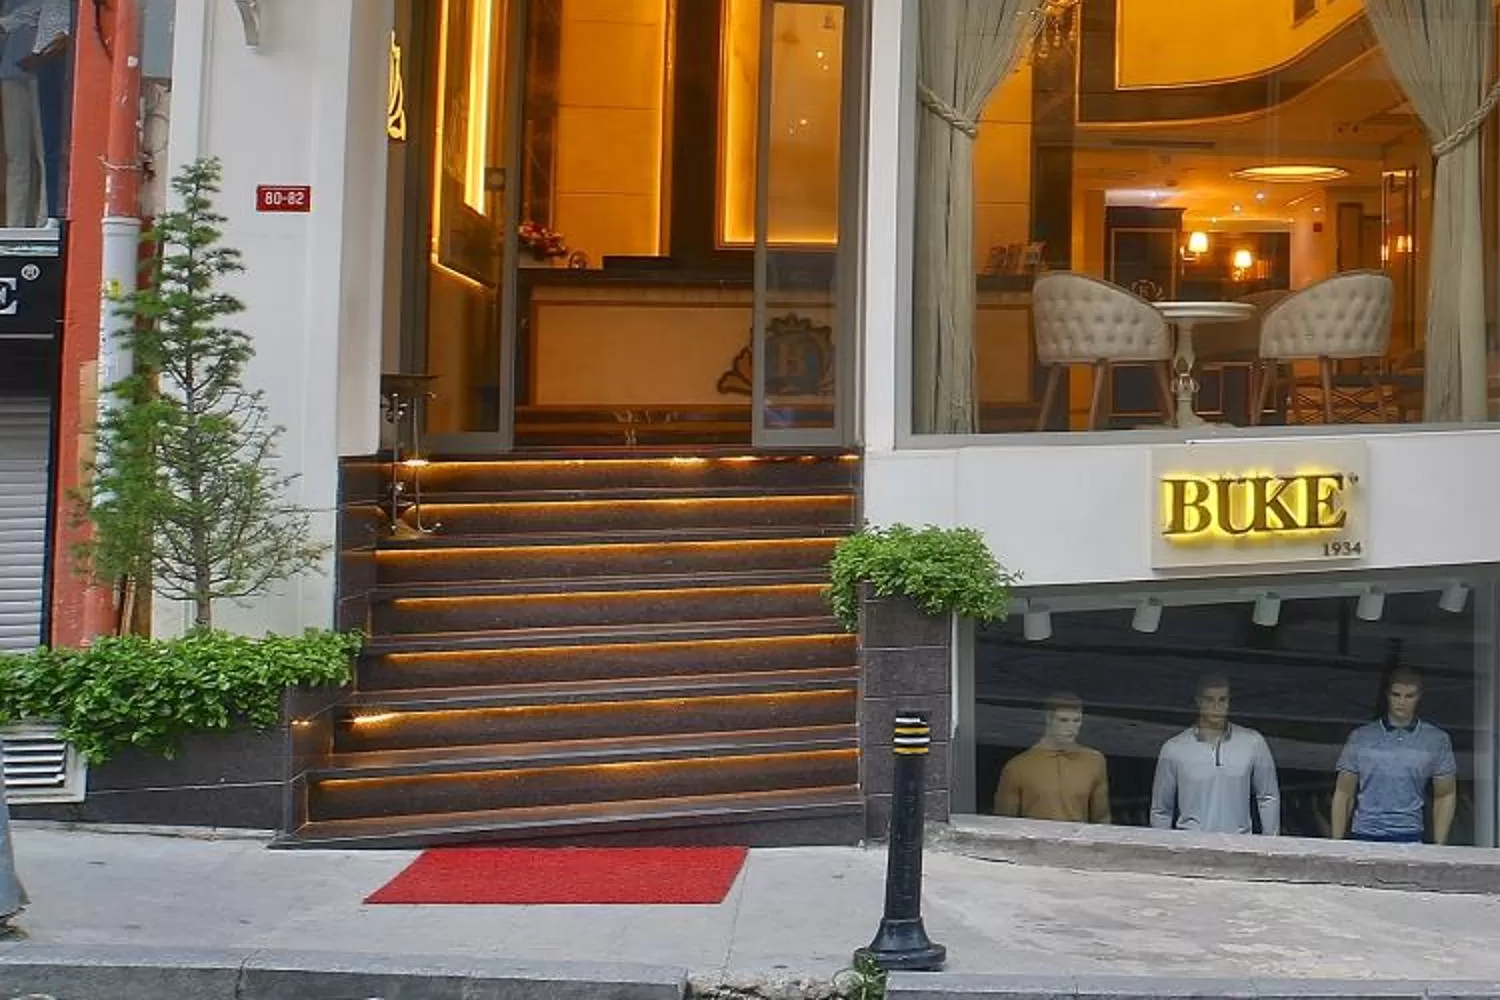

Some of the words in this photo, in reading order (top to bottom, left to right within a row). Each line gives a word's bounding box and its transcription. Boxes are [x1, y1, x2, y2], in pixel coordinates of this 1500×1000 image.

[265, 191, 305, 205] 80-82
[1160, 471, 1347, 535] BUKE
[1322, 541, 1361, 556] 1934
